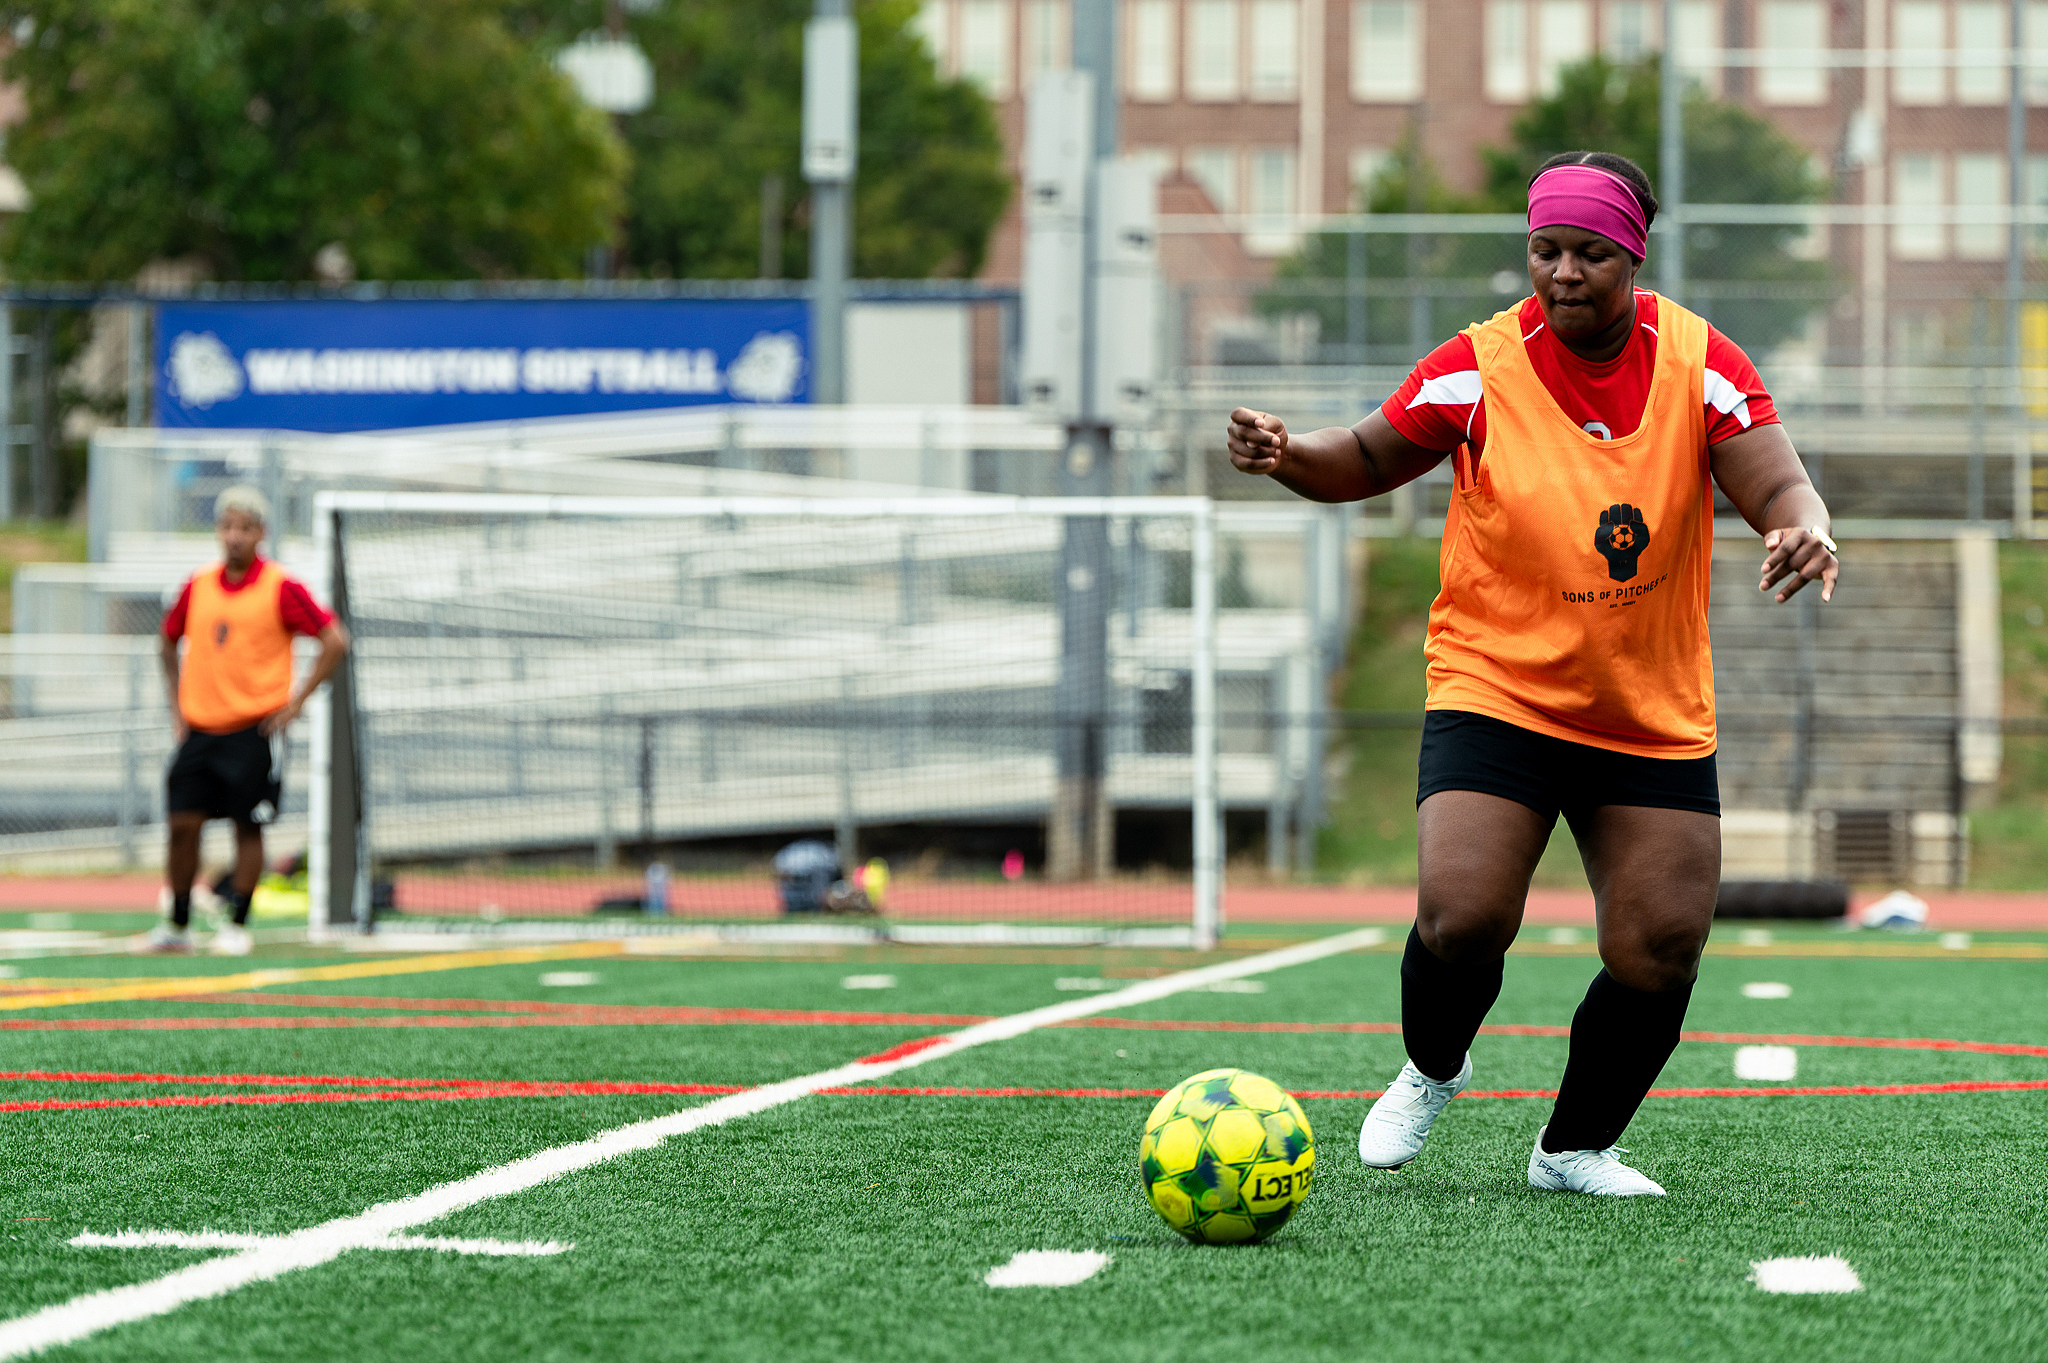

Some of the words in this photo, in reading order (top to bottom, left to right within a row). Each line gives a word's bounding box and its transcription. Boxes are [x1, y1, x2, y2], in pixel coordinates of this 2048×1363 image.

[246, 348, 518, 394] WASHINGTON
[524, 348, 721, 394] SOFTBALL
[1562, 591, 1594, 603] SONS
[1600, 591, 1611, 600] OF
[1616, 578, 1659, 599] PITCHES
[1251, 1165, 1314, 1201] ELECT
